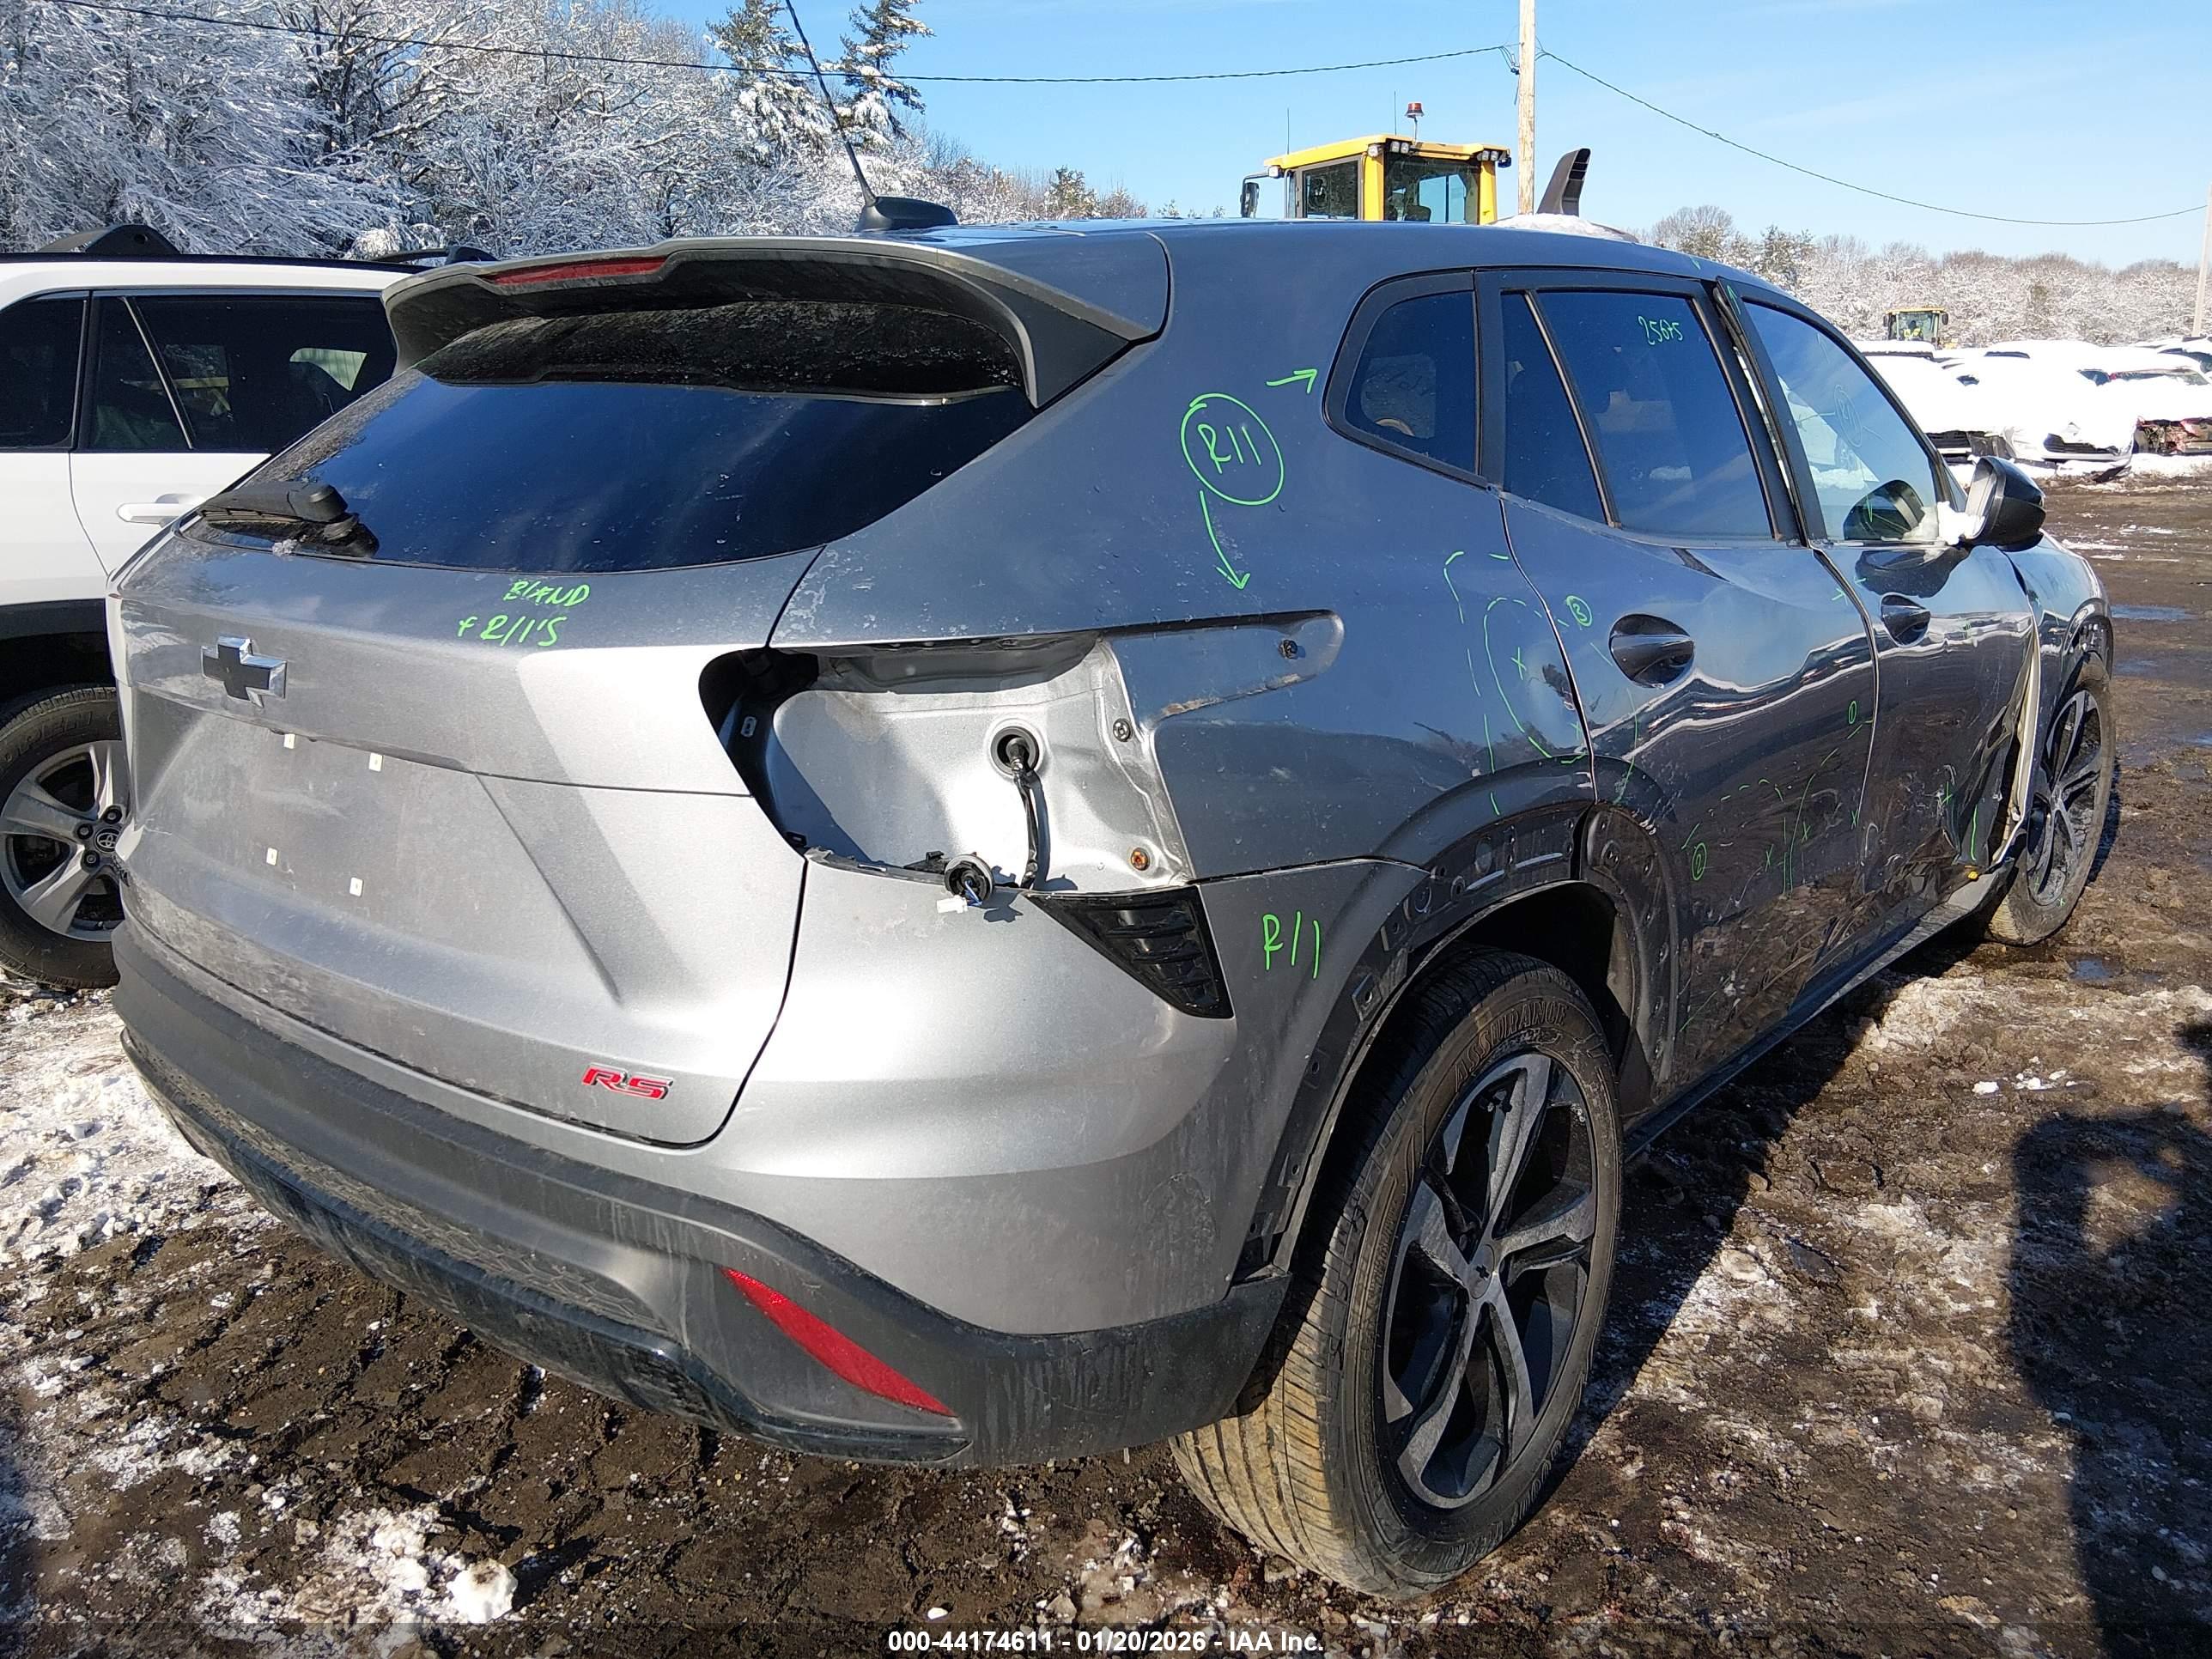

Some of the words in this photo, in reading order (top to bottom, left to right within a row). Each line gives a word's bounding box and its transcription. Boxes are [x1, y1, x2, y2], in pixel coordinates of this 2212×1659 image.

[1197, 423, 1262, 474] R11
[1262, 910, 1321, 980] R11
[581, 1062, 675, 1100] RS
